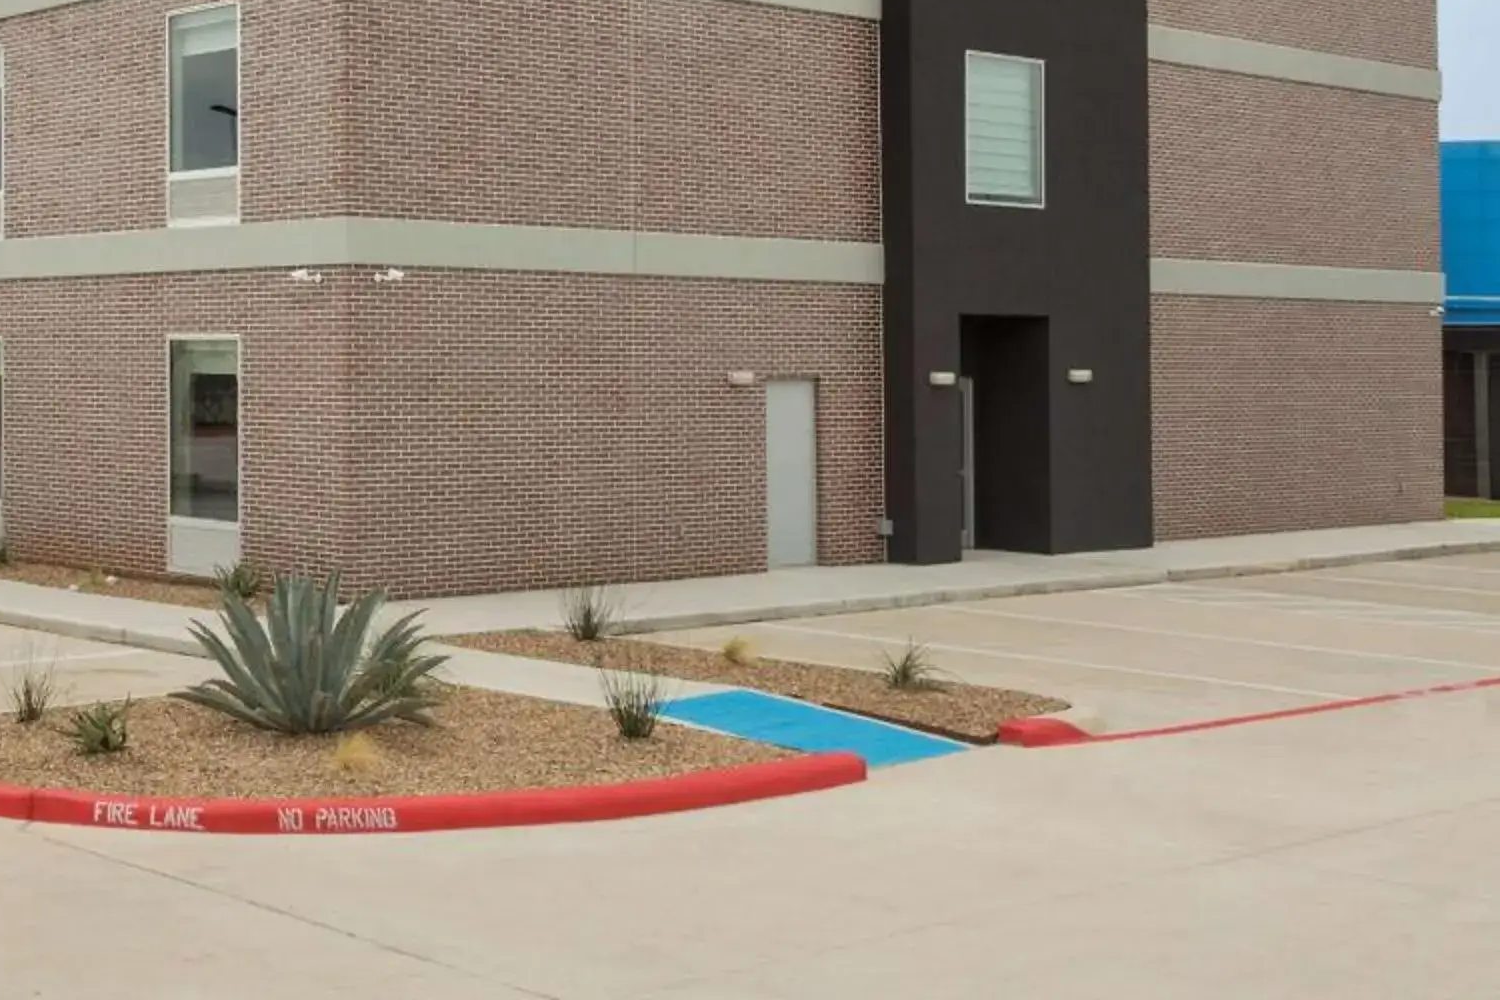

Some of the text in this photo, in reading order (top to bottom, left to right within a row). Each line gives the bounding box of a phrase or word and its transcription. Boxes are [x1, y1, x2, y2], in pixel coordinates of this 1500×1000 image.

[93, 799, 397, 832] FIRE LANE NO PARKING
